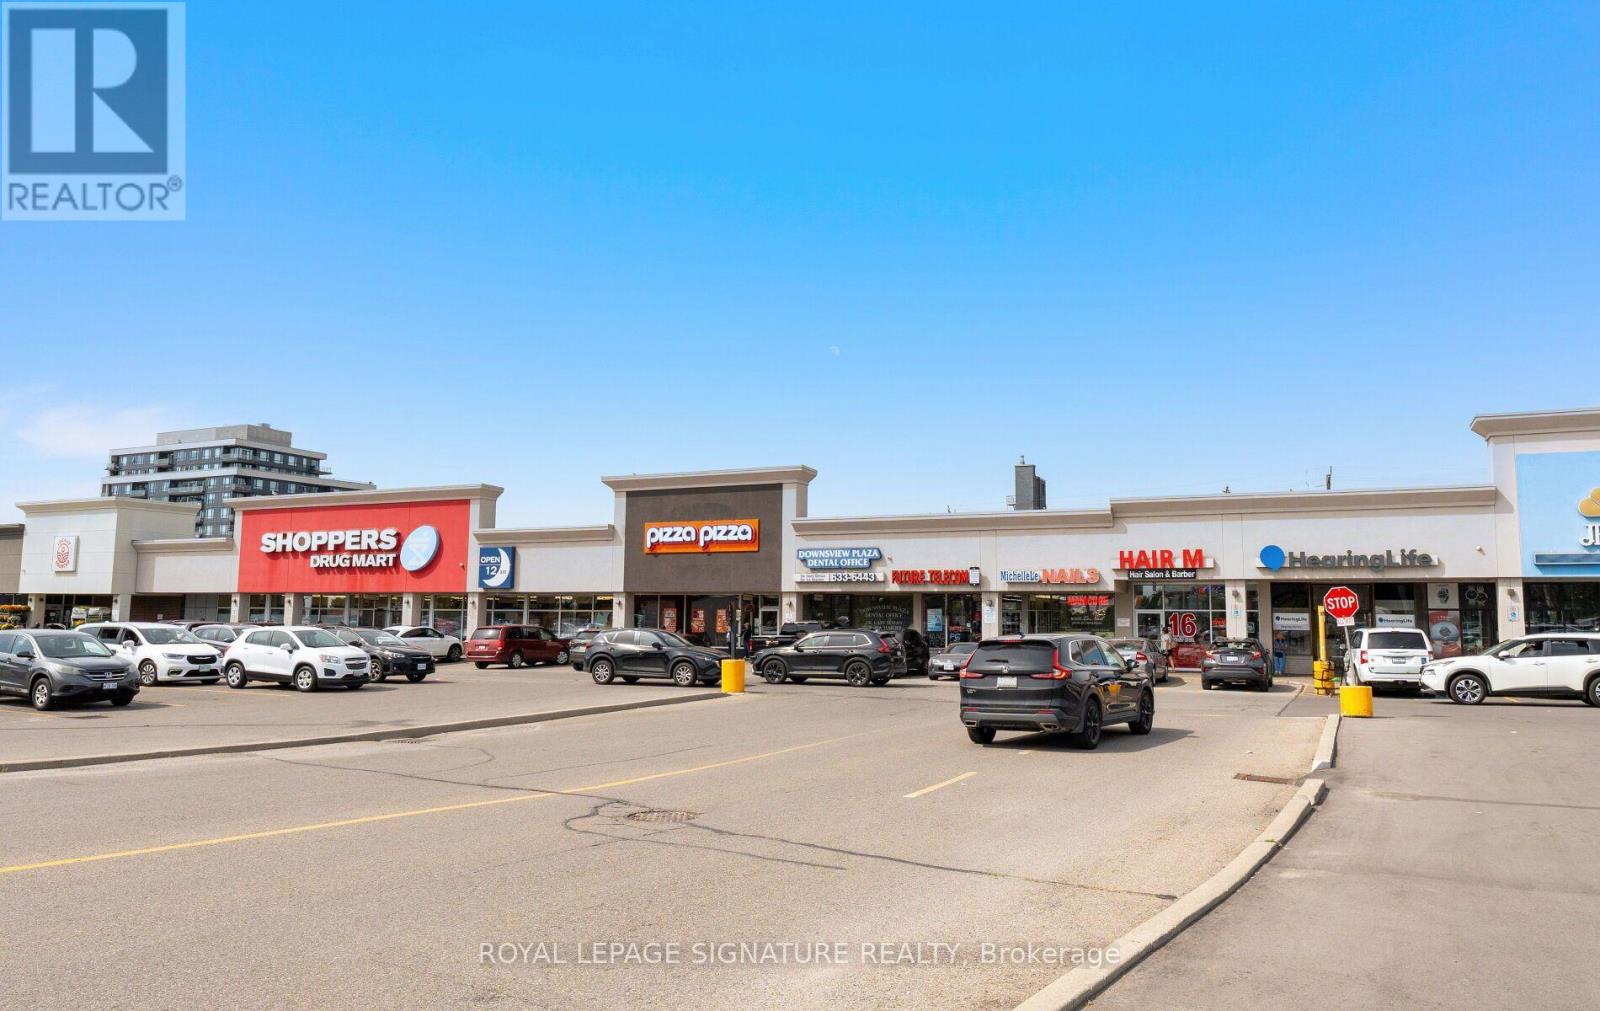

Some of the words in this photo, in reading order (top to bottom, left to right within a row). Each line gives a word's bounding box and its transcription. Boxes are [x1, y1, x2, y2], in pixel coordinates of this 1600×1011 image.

[260, 527, 398, 554] SHOPPERS
[646, 525, 696, 548] pizza
[699, 523, 753, 547] pizza
[309, 554, 351, 569] DRUG
[352, 553, 397, 568] MART
[480, 556, 501, 564] OPEN
[798, 549, 850, 559] DOWNSVIEW
[851, 549, 879, 558] PLAZA
[807, 558, 838, 567] DENTAL
[839, 557, 869, 567] OFFICE
[1119, 550, 1174, 569] HAIR
[1182, 548, 1205, 569] M
[1288, 548, 1433, 572] HearingLife
[485, 566, 498, 576] 12
[891, 569, 926, 585] FUTURE
[927, 569, 969, 585] TELECOM
[1041, 567, 1100, 584] NAILS
[1144, 570, 1164, 578] Salon
[1165, 570, 1171, 578] &
[1171, 570, 1196, 578] Barber
[1326, 596, 1356, 610] STOP
[1168, 612, 1198, 638] 16
